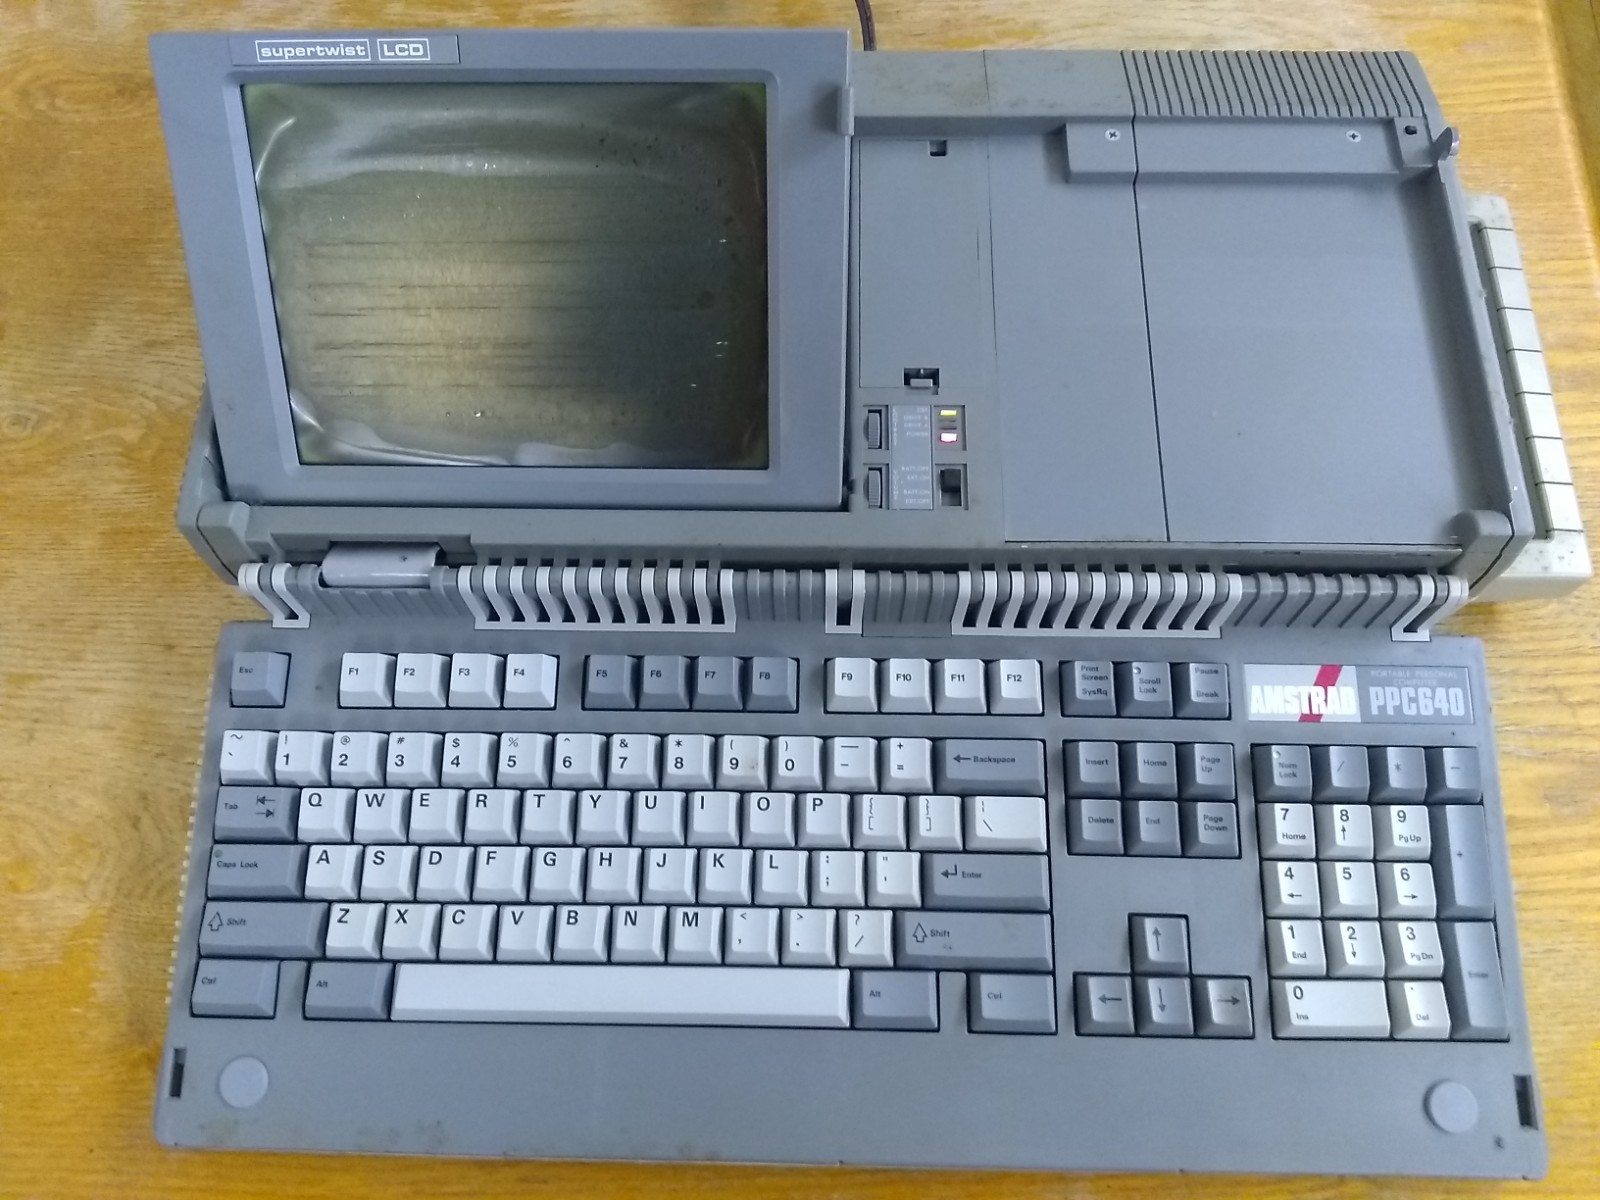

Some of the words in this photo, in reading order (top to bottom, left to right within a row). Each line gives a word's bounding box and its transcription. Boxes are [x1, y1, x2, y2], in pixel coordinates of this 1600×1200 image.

[261, 44, 366, 59] supertwist
[383, 43, 424, 56] LCD
[239, 666, 253, 674] Esc
[348, 667, 359, 675] F1
[403, 668, 415, 676] F2
[458, 668, 470, 676] F3
[513, 668, 525, 676] F4
[596, 669, 608, 678] F5
[650, 670, 662, 678] F6
[705, 671, 716, 679] F7
[759, 672, 771, 680] F8
[841, 672, 853, 681] F9
[896, 673, 912, 682] F10
[951, 674, 965, 682] F11
[1007, 674, 1022, 682] F12
[1250, 686, 1357, 715] AMSTRAD
[1370, 686, 1466, 716] PPC640
[619, 738, 628, 748] &
[283, 753, 290, 765] 1
[338, 753, 348, 766] 2
[394, 754, 404, 767] 3
[450, 755, 460, 768] 4
[507, 755, 517, 768] 5
[563, 756, 572, 768] 6
[619, 756, 628, 769] 7
[674, 756, 684, 769] 8
[729, 757, 739, 770] 9
[785, 758, 795, 771] 0
[973, 755, 1016, 764] Backspace
[1201, 756, 1221, 765] Page
[308, 792, 322, 807] Q
[365, 793, 385, 807] W
[419, 793, 430, 807] E
[475, 794, 487, 808] R
[533, 794, 546, 808] T
[589, 794, 601, 809] Y
[645, 795, 657, 809] U
[699, 795, 705, 811] I
[757, 797, 770, 811] O
[812, 797, 823, 812] P
[1280, 808, 1289, 821] 7
[1340, 809, 1349, 822] 8
[1397, 810, 1407, 823] 9
[316, 849, 330, 864] A
[373, 850, 385, 865] S
[428, 851, 442, 865] D
[486, 851, 497, 865] F
[543, 851, 556, 866] G
[599, 852, 612, 867] H
[656, 853, 667, 868] J
[713, 853, 725, 868] K
[769, 854, 779, 869] L
[962, 871, 982, 879] Enter
[1284, 866, 1294, 880] 4
[1343, 867, 1352, 880] 5
[1400, 867, 1410, 881] 6
[226, 918, 246, 926] Shift
[337, 908, 350, 924] Z
[395, 909, 408, 924] X
[452, 909, 466, 925] C
[511, 910, 524, 925] V
[566, 910, 578, 925] B
[624, 910, 637, 926] N
[682, 911, 699, 927] M
[930, 929, 950, 938] Shift
[1288, 925, 1295, 939] 1
[1347, 926, 1357, 940] 2
[1406, 926, 1416, 941] 3
[1292, 951, 1307, 959] End
[1293, 985, 1304, 1000] 0
